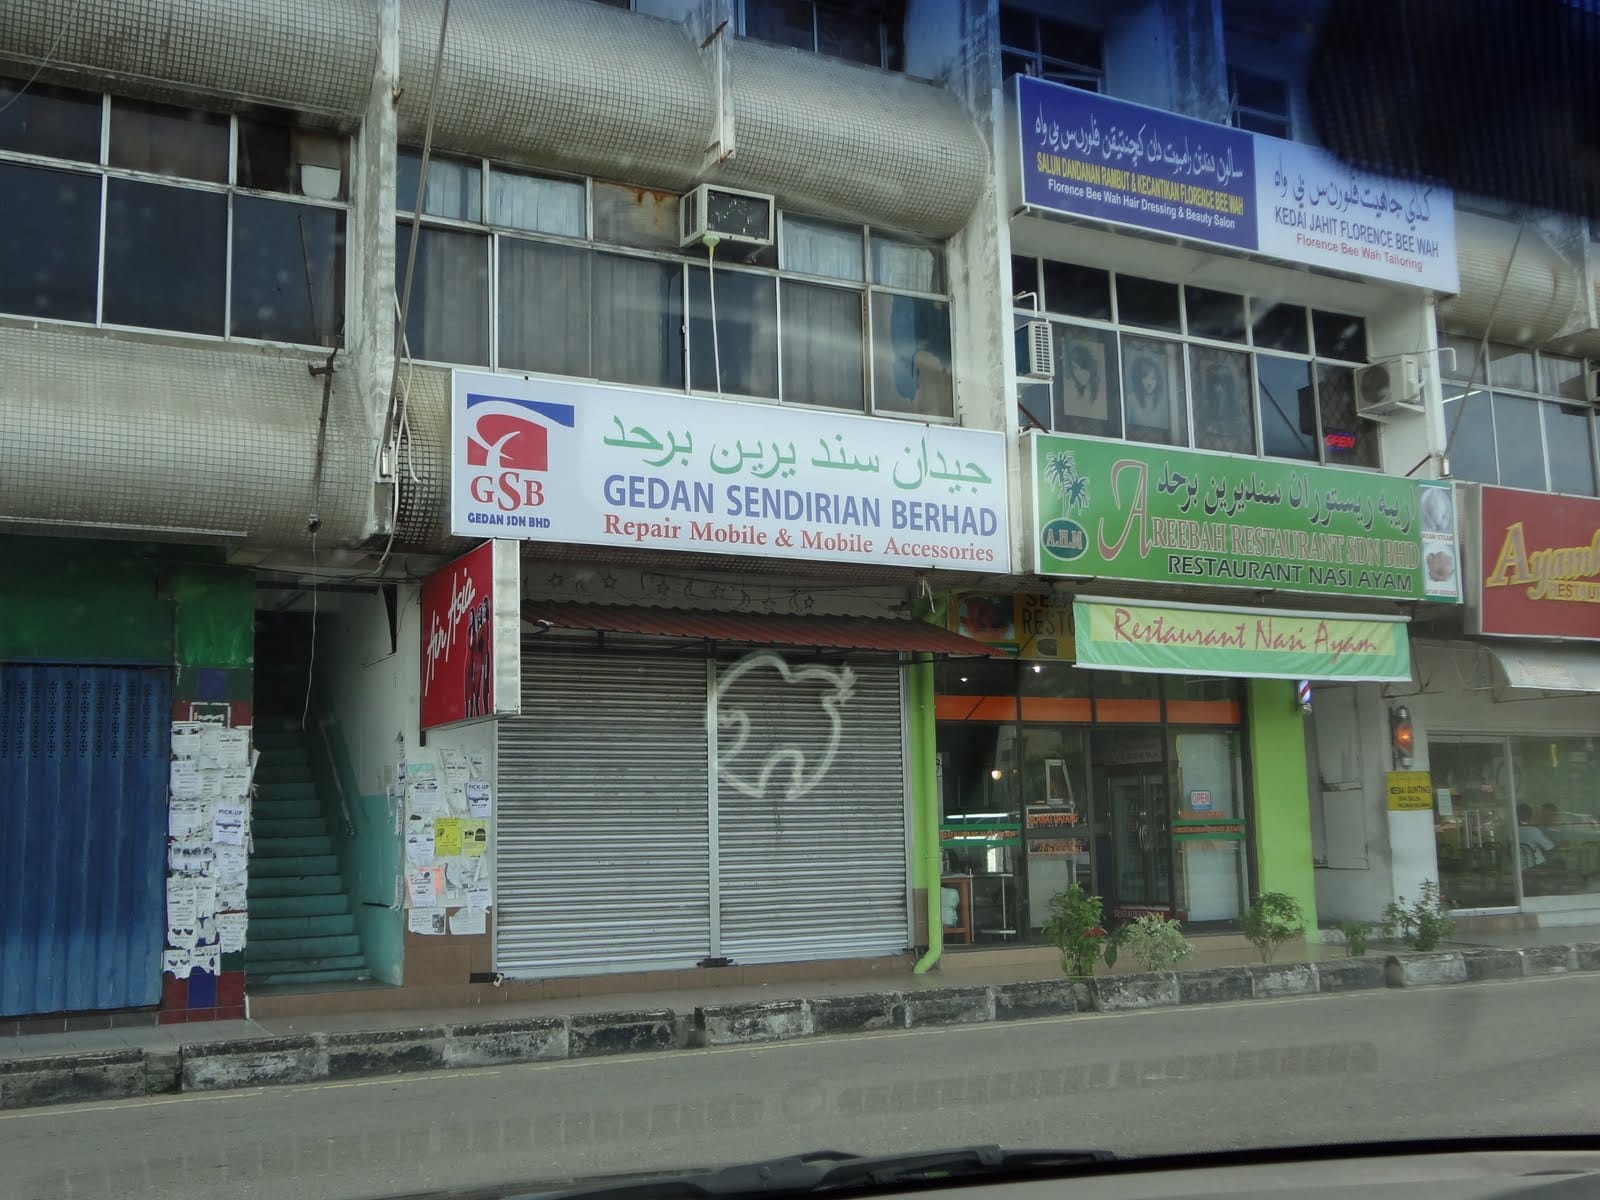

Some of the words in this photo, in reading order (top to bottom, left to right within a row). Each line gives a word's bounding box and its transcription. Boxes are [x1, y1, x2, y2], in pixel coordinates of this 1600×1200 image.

[1048, 178, 1085, 198] Florence
[1086, 185, 1102, 201] Bee
[1103, 189, 1122, 205] Wah
[1123, 194, 1140, 210] Hair
[1141, 196, 1177, 219] Dressing
[1178, 204, 1185, 218] &
[1186, 207, 1213, 228] Beauty
[1213, 213, 1236, 230] Salon
[1061, 157, 1101, 185] DANDANAN
[1101, 166, 1131, 192] RAMBUT
[1131, 173, 1137, 193] &
[1137, 174, 1180, 201] KECANTIKAN
[1180, 183, 1215, 210] FLORENCE
[1215, 190, 1229, 212] BEE
[1228, 195, 1244, 216] WAH
[1275, 205, 1307, 228] KEDAI
[1309, 213, 1338, 238] JAHIT
[1340, 220, 1393, 248] FLORENCE
[1395, 231, 1415, 253] BEE
[1416, 238, 1440, 258] WAH
[1296, 232, 1338, 253] Florence
[1341, 242, 1359, 257] Bee
[1361, 244, 1382, 261] Wah
[1383, 250, 1423, 272] Tailoring
[603, 415, 692, 467] برحد
[709, 439, 796, 479] يرين
[811, 433, 880, 473] سند
[892, 436, 992, 494] جيدان
[470, 471, 545, 511] GSB
[604, 474, 714, 514] GEDAN
[726, 485, 881, 527] SENDIRIAN
[892, 499, 997, 537] BERHAD
[1098, 459, 1228, 561] AREEBAH
[1230, 524, 1345, 564] RESTAURANT
[1347, 535, 1381, 567] SDN
[1383, 540, 1420, 570] BHD
[467, 512, 504, 526] GEDAN
[507, 515, 526, 527] SDN
[529, 517, 551, 529] BHD
[603, 513, 681, 542] Repair
[689, 520, 767, 545] Mobile
[775, 528, 794, 548] &
[800, 530, 873, 553] Mobile
[883, 536, 994, 562] Accessories
[1168, 554, 1303, 584] RESTAURANT
[1308, 566, 1352, 587] NASI
[1358, 570, 1413, 592] AYAM
[424, 609, 447, 697] Air
[445, 567, 476, 663] Asia
[1113, 607, 1246, 649] Restaurant
[1255, 617, 1306, 651] Nasi
[1314, 620, 1377, 665] Ayam
